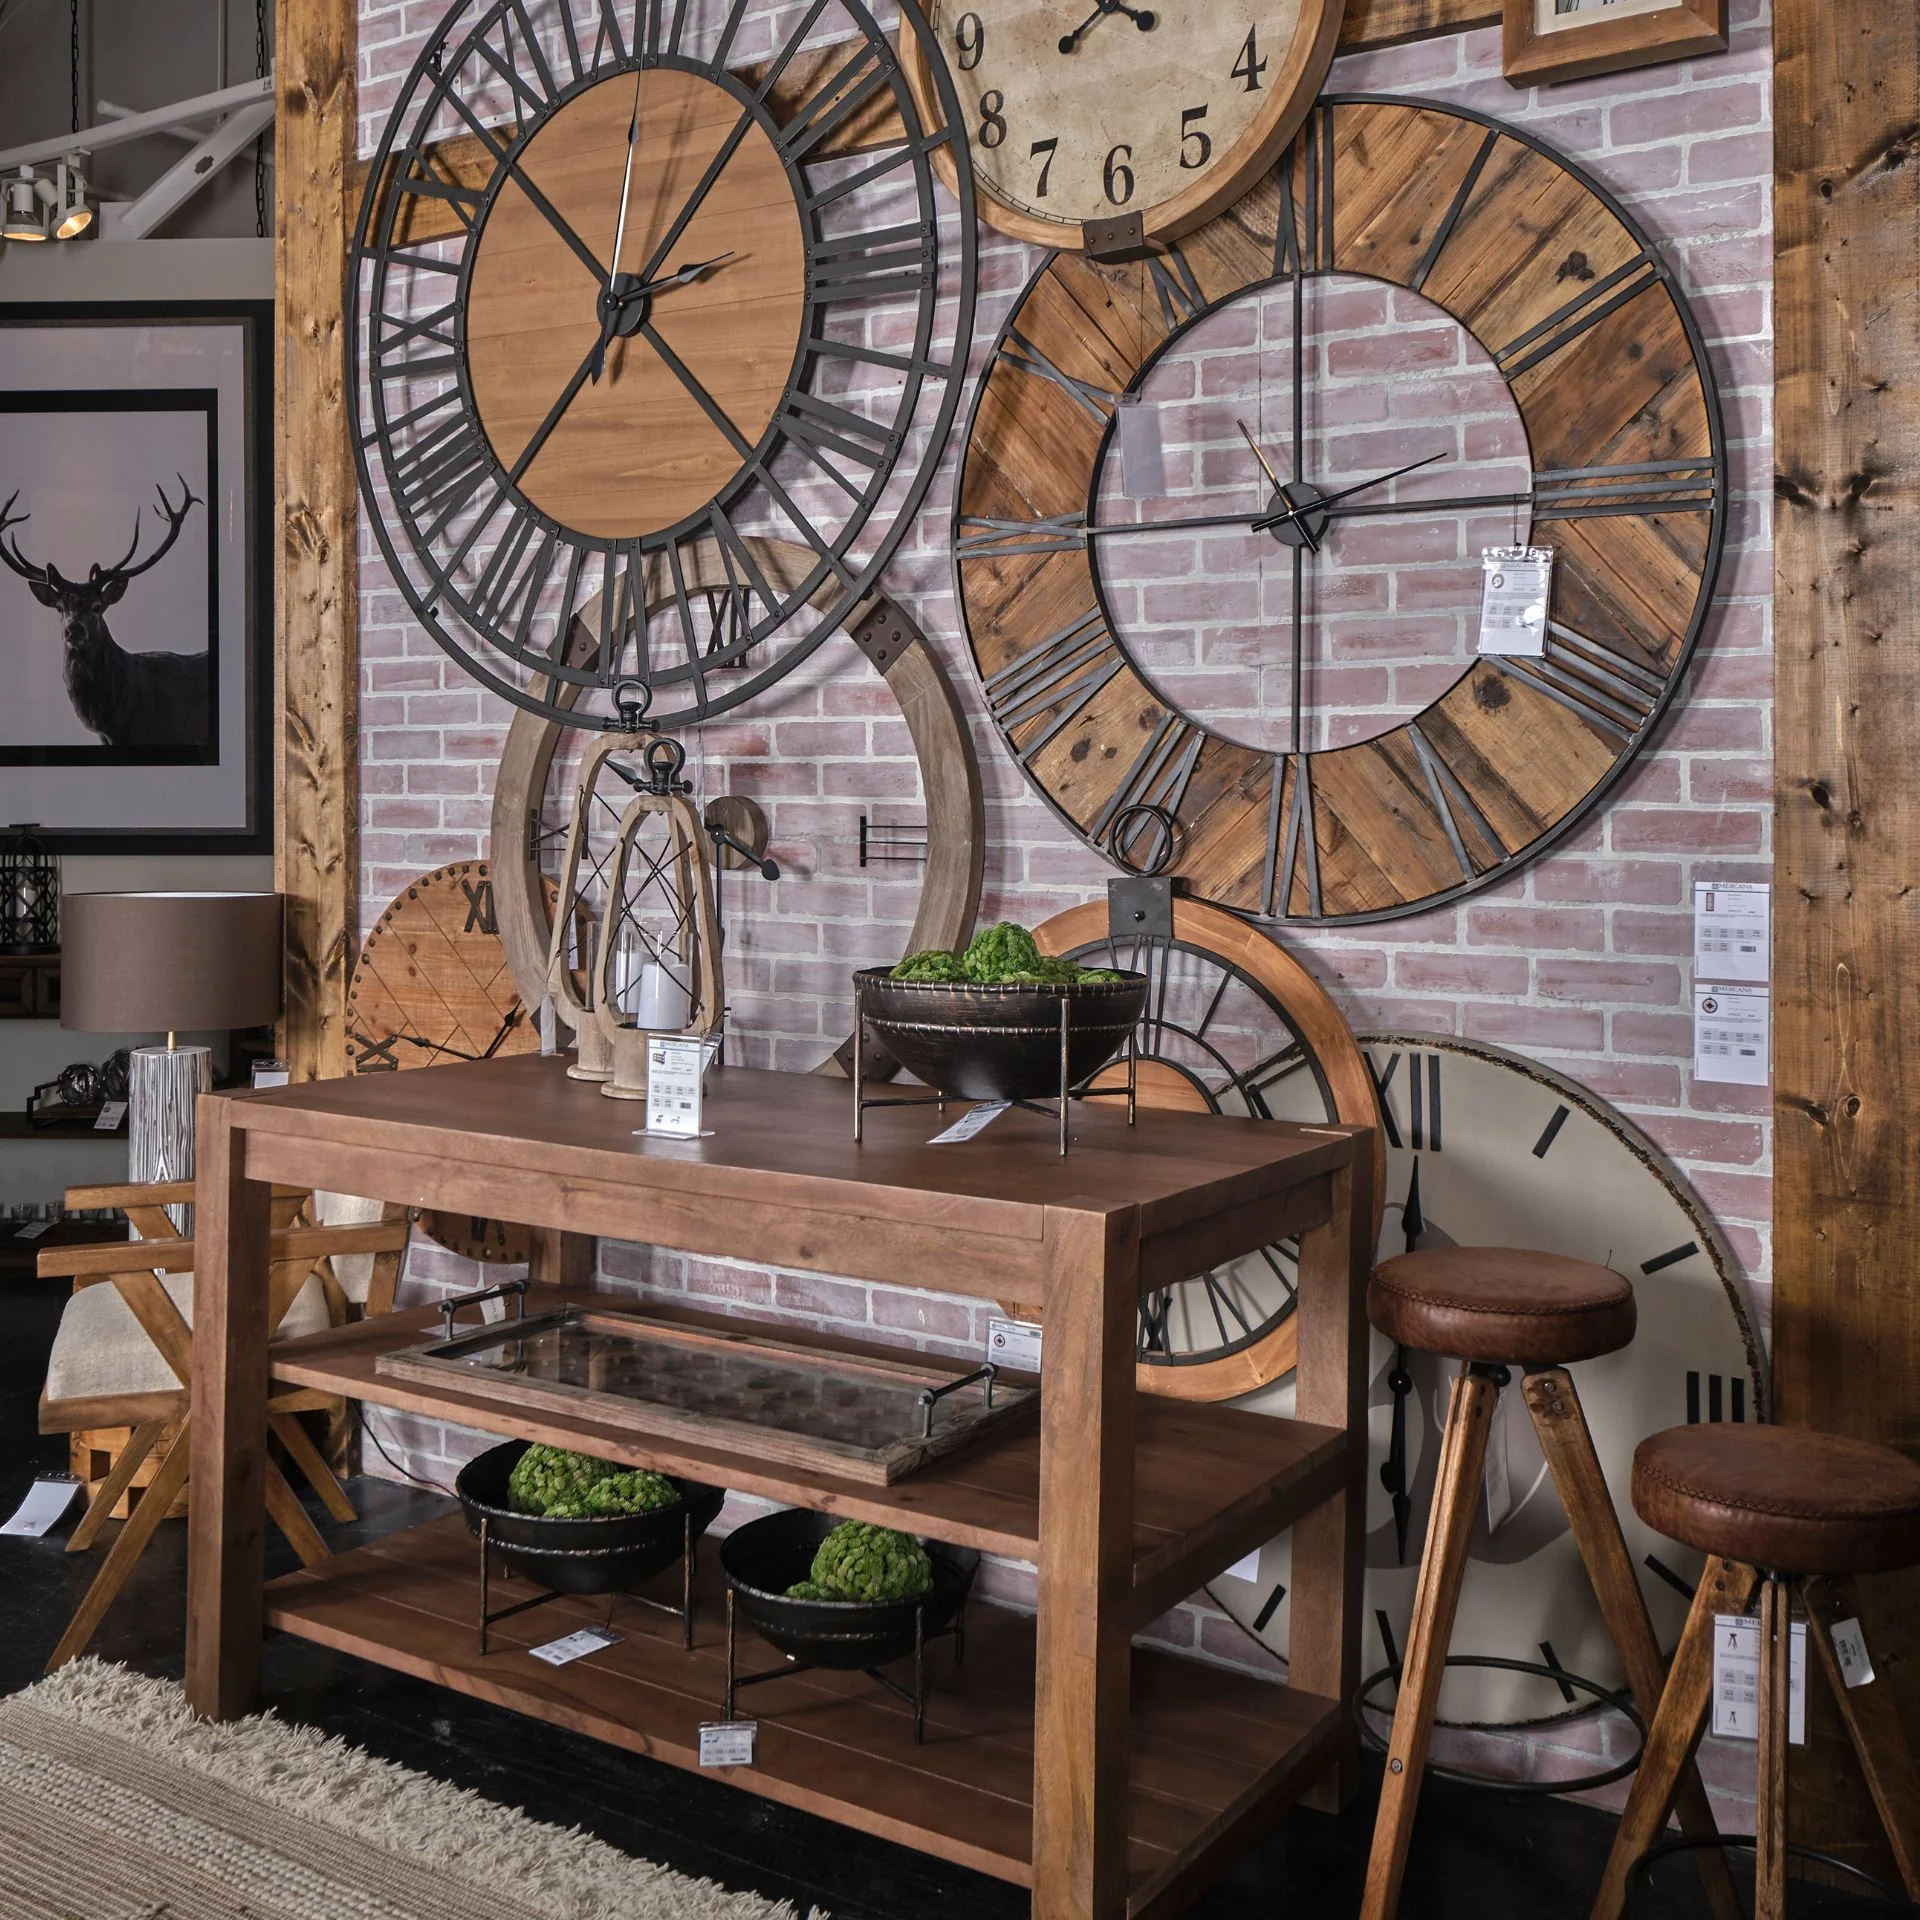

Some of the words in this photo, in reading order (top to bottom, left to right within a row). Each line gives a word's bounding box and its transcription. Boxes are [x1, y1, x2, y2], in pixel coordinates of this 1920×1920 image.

[956, 12, 984, 71] 9
[1230, 23, 1268, 93] 4
[978, 90, 1006, 149] 8
[1179, 103, 1211, 169] 5
[1030, 137, 1058, 198] 7
[1103, 144, 1135, 206] 6
